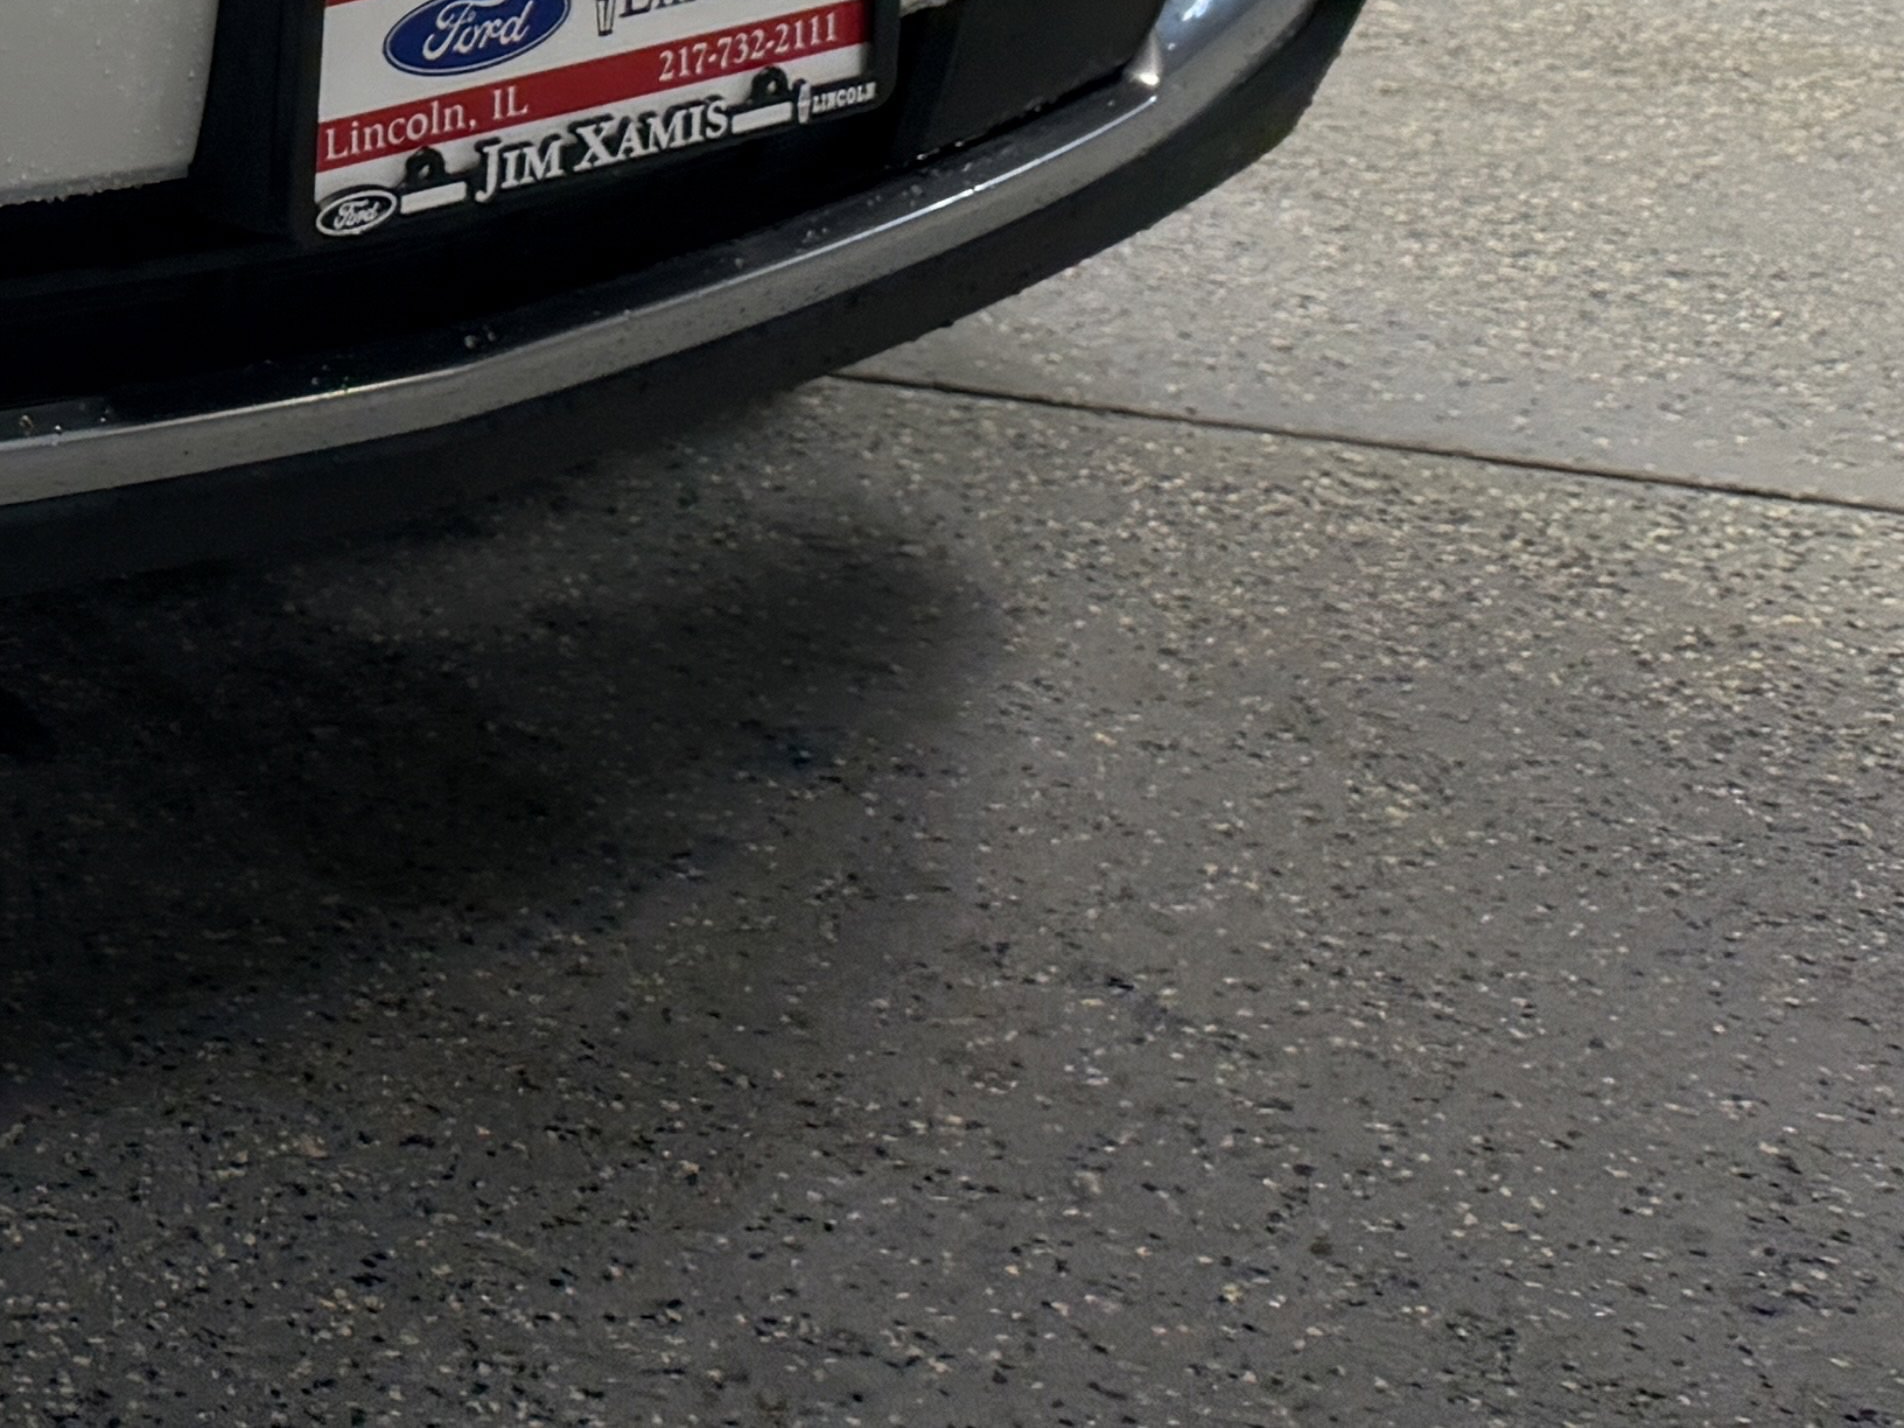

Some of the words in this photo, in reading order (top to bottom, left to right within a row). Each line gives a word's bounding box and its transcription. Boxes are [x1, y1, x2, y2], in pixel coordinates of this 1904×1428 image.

[658, 12, 837, 82] 217-732-2111
[325, 100, 477, 161] Lincoln,
[492, 86, 529, 120] IL
[812, 81, 877, 114] LINCOLN
[474, 137, 567, 203] JIM
[573, 100, 728, 173] XAMIS
[333, 198, 381, 230] Ford
